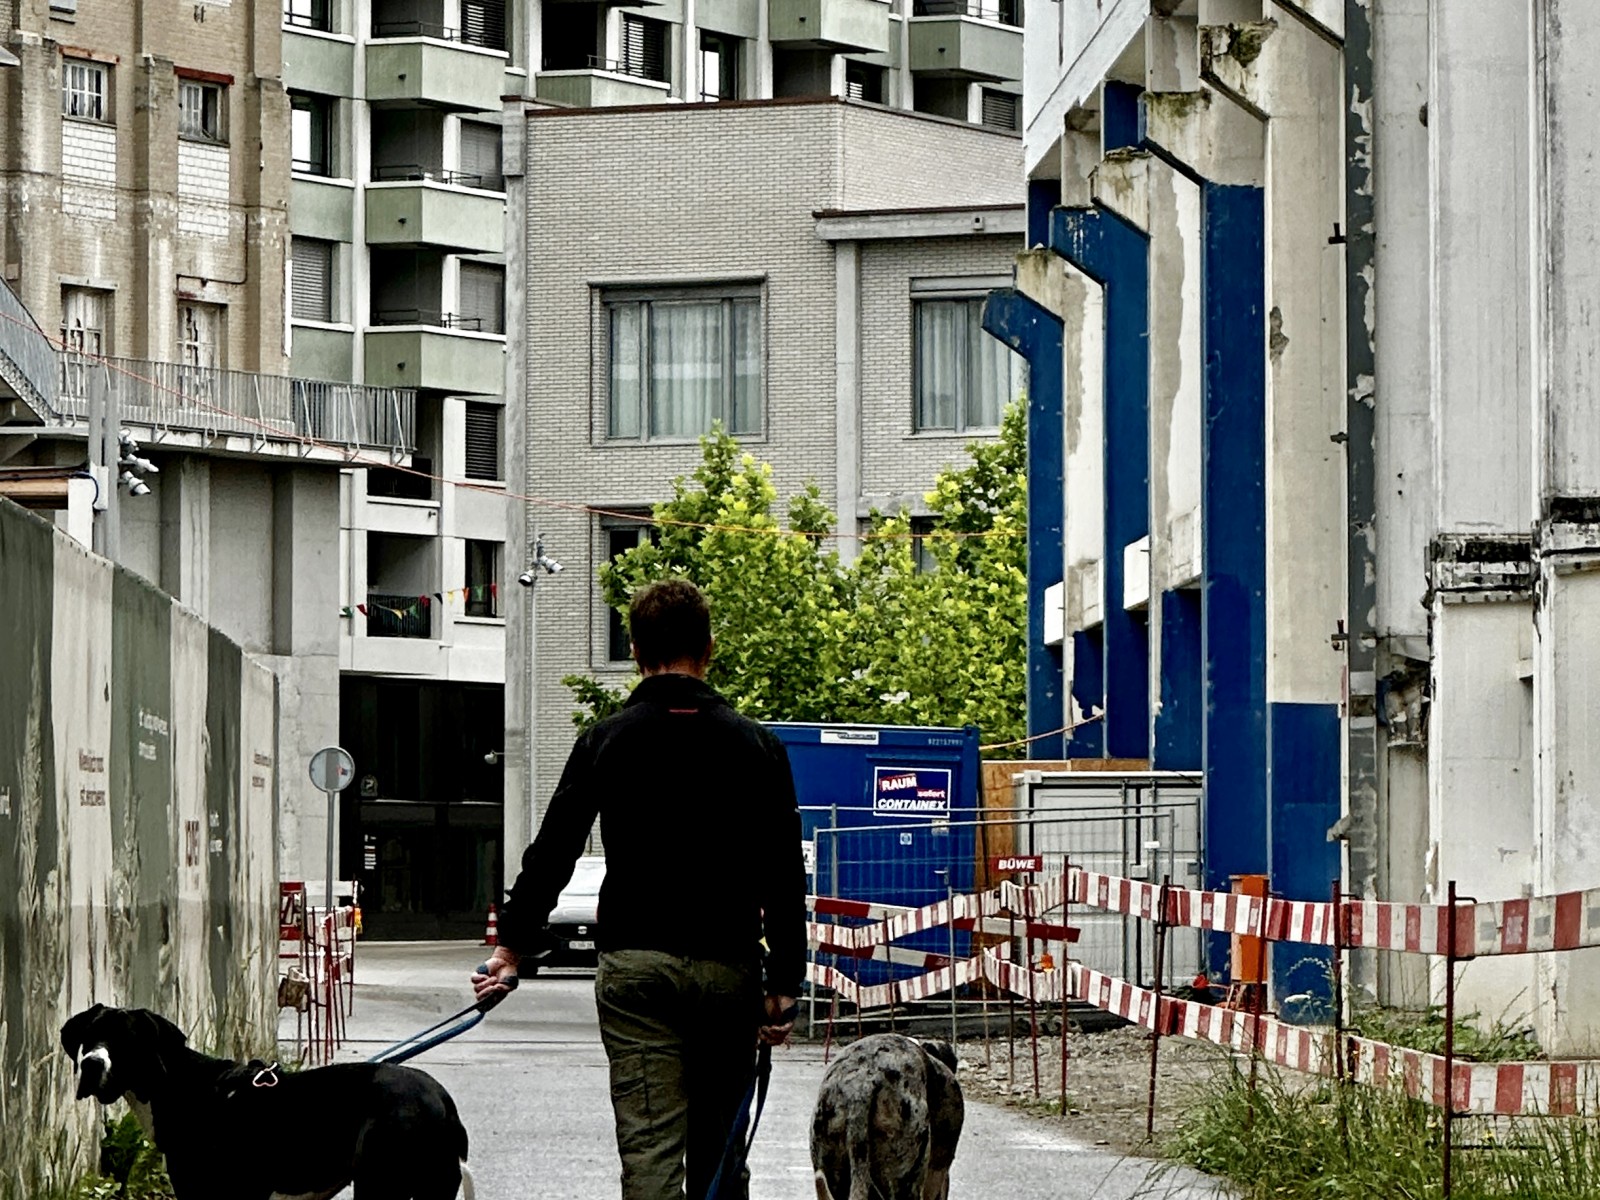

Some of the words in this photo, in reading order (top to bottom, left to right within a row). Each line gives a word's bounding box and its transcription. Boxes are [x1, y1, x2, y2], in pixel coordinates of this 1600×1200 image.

[881, 776, 917, 792] RAUM
[917, 790, 946, 798] sofort
[878, 798, 946, 811] CONTAINEX
